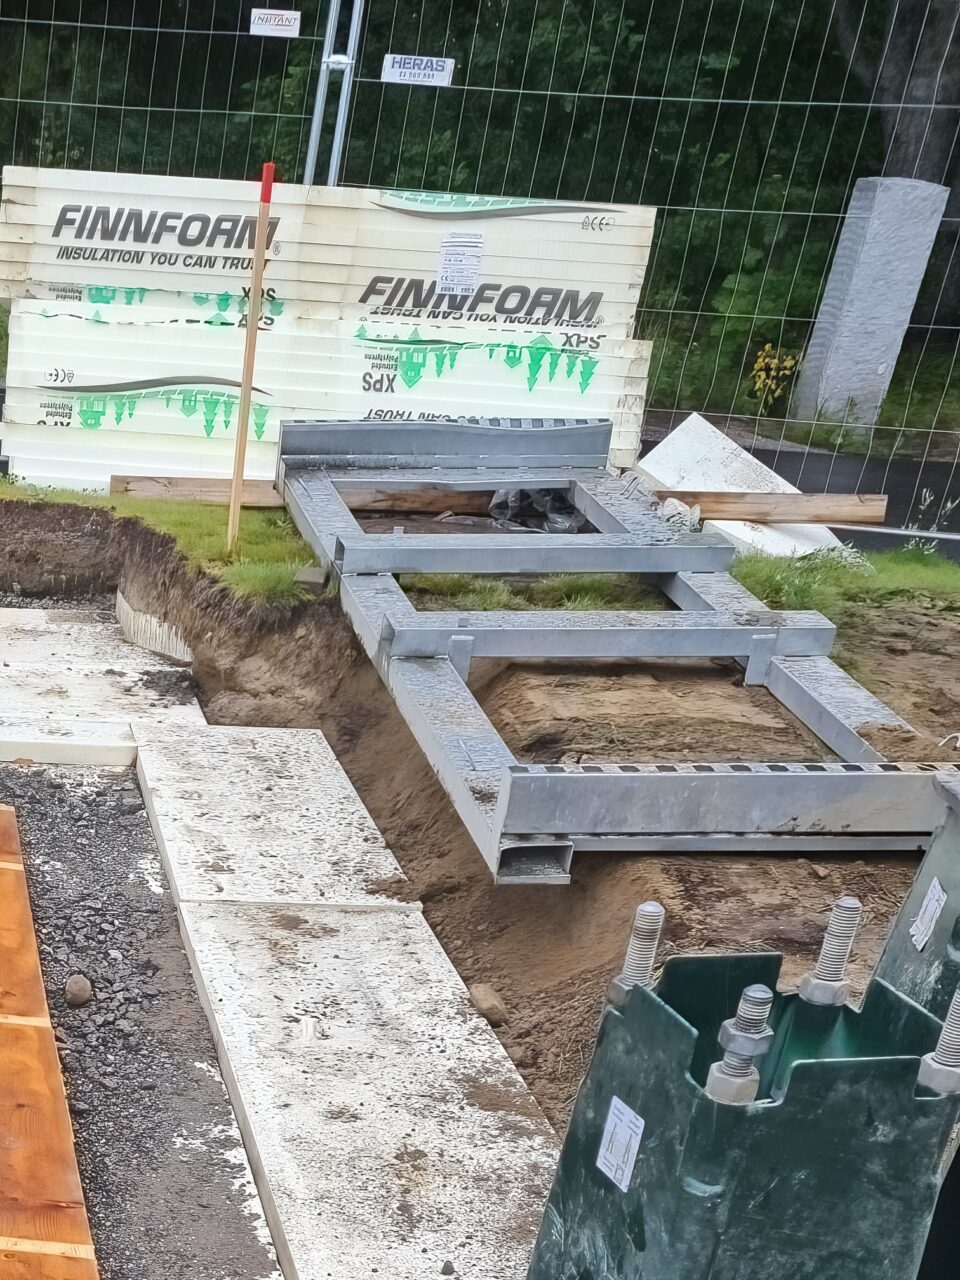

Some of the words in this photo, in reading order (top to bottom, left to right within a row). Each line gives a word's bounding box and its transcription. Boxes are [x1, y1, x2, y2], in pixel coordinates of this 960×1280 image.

[391, 56, 446, 72] HERAS
[56, 246, 145, 264] INSULATION
[149, 252, 180, 266] YOU
[182, 255, 217, 270] CAN
[371, 362, 398, 371] Extruded
[362, 372, 398, 393] XPS
